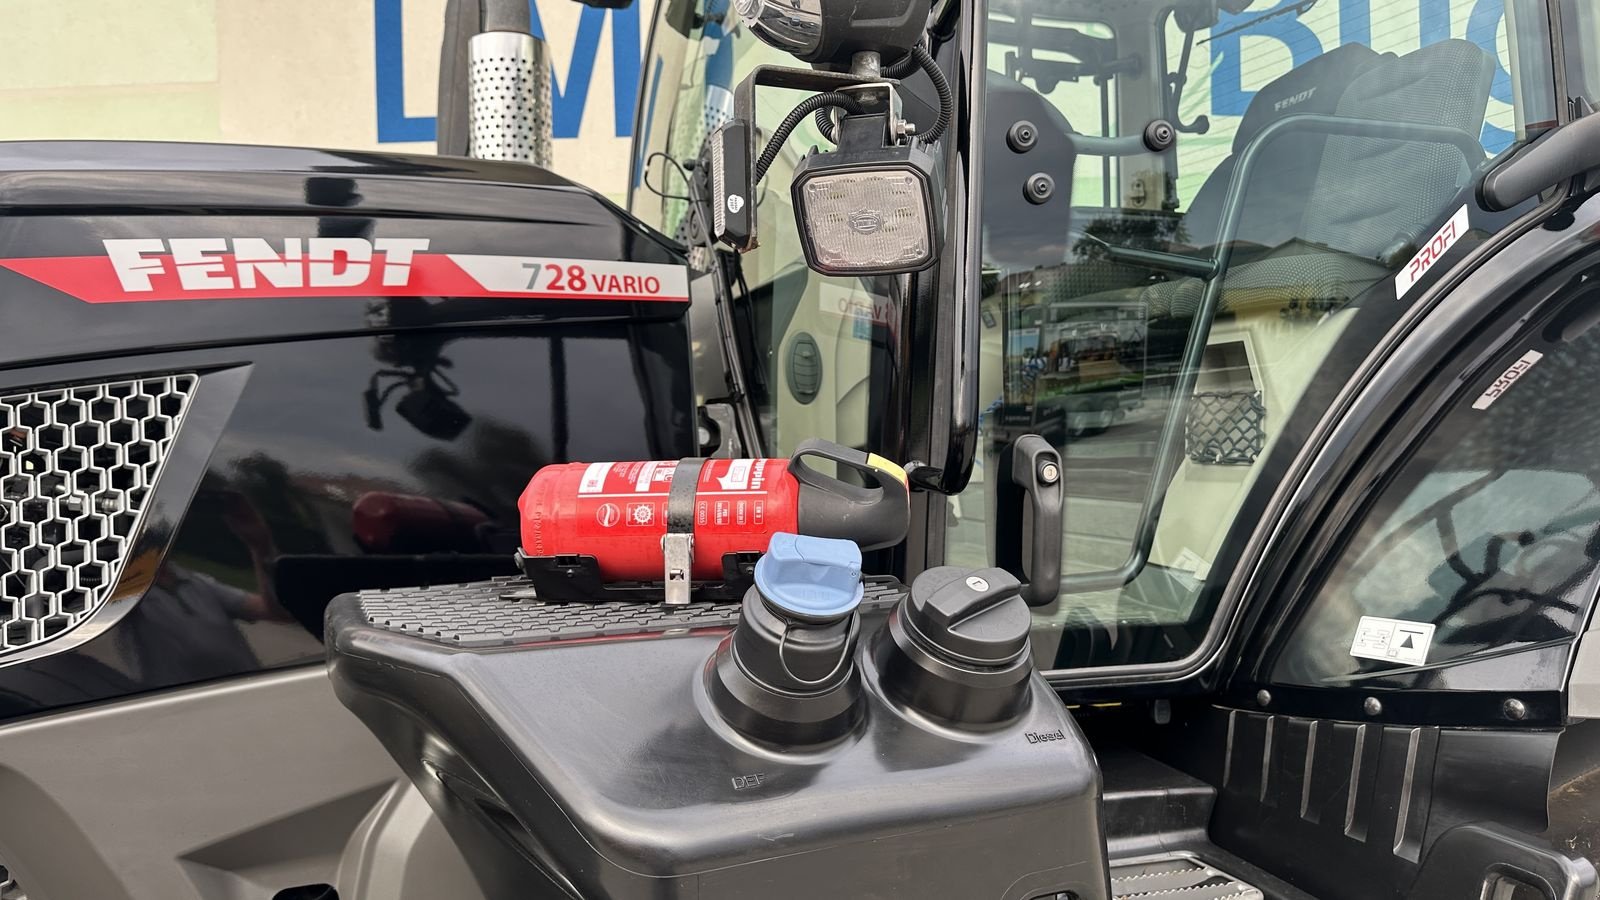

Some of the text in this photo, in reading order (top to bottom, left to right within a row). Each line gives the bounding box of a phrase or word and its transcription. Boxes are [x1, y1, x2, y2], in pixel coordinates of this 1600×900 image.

[1274, 86, 1317, 111] FENDT
[102, 237, 430, 292] FENDT
[1409, 220, 1456, 282] PROFI
[522, 262, 660, 294] 728 VARIO
[1024, 729, 1066, 744] Diesel
[731, 773, 764, 790] DEF
